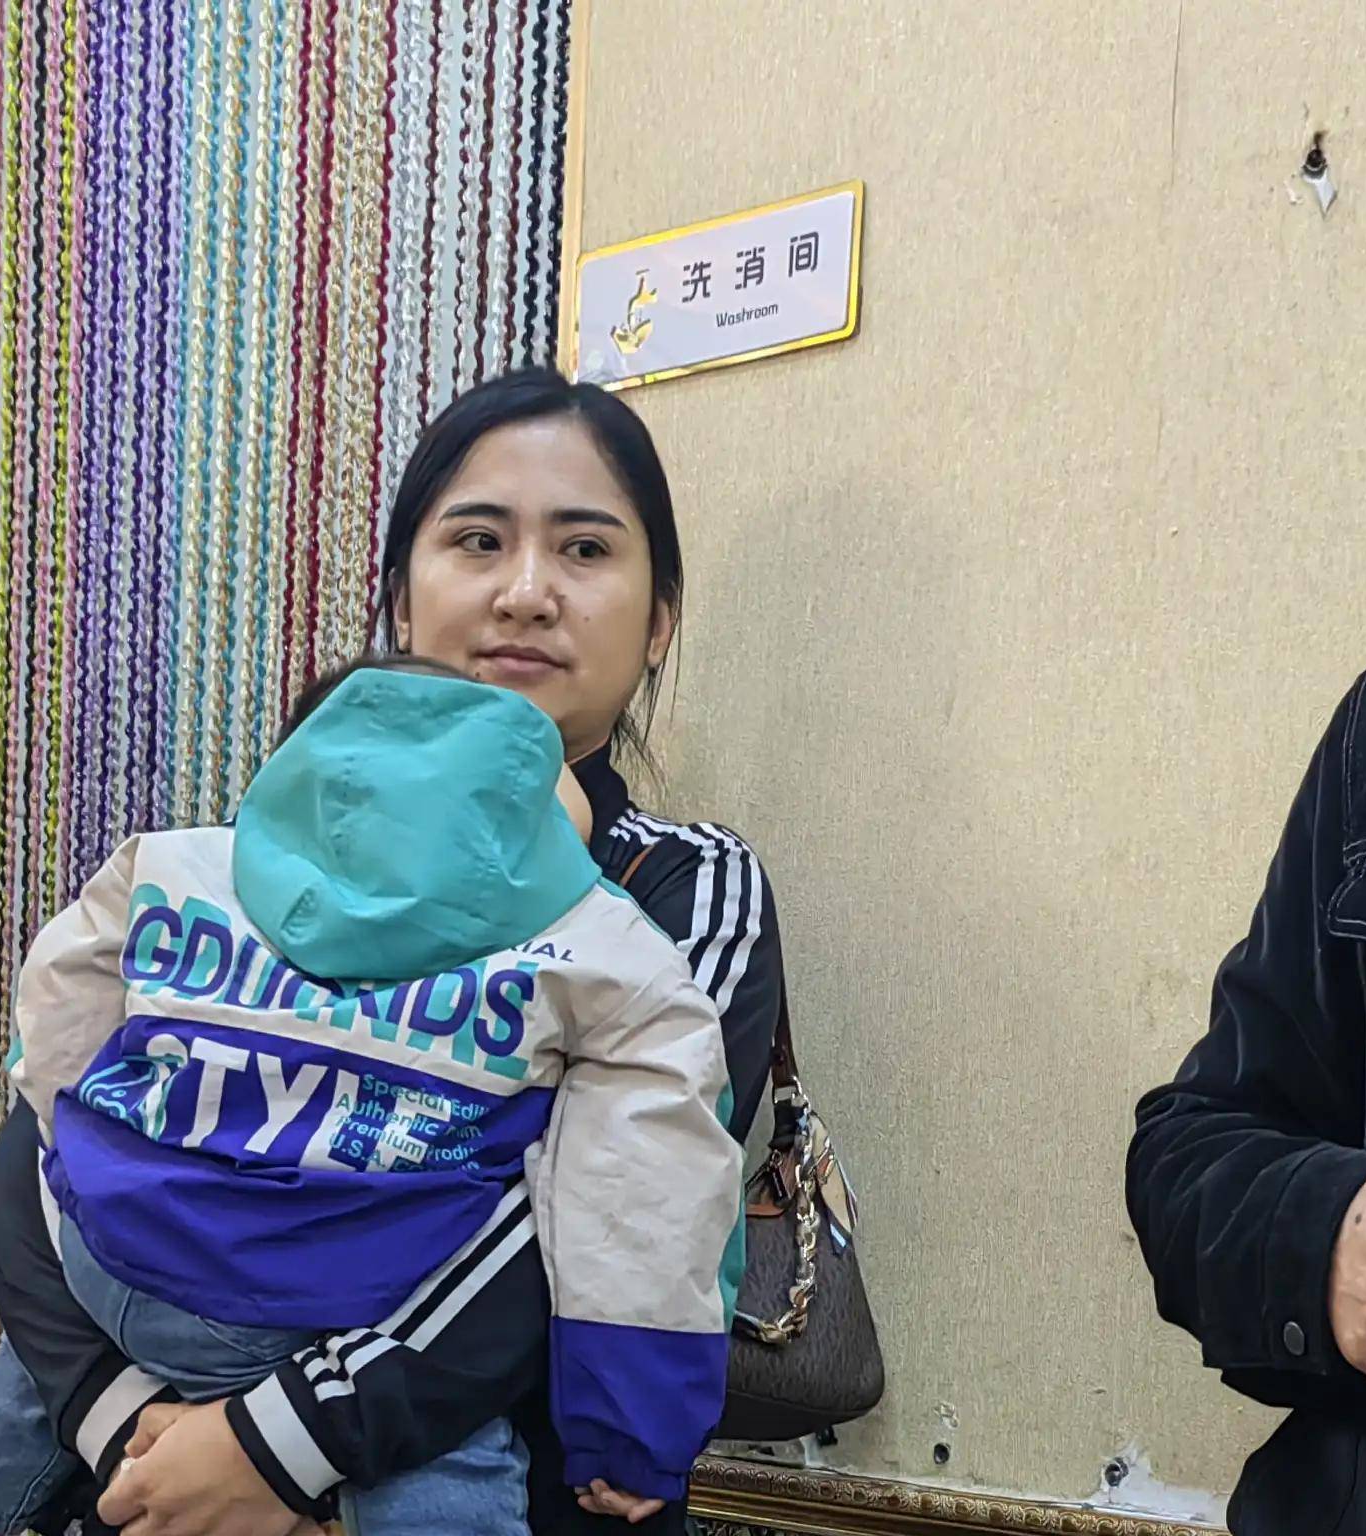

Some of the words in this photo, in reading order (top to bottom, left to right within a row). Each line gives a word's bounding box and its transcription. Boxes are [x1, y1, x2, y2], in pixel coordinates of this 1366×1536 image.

[681, 231, 820, 303] 洗消间
[715, 302, 779, 328] Washroom
[336, 1092, 440, 1137] Authentic
[362, 1073, 446, 1112] Special
[336, 1115, 429, 1160] Premium
